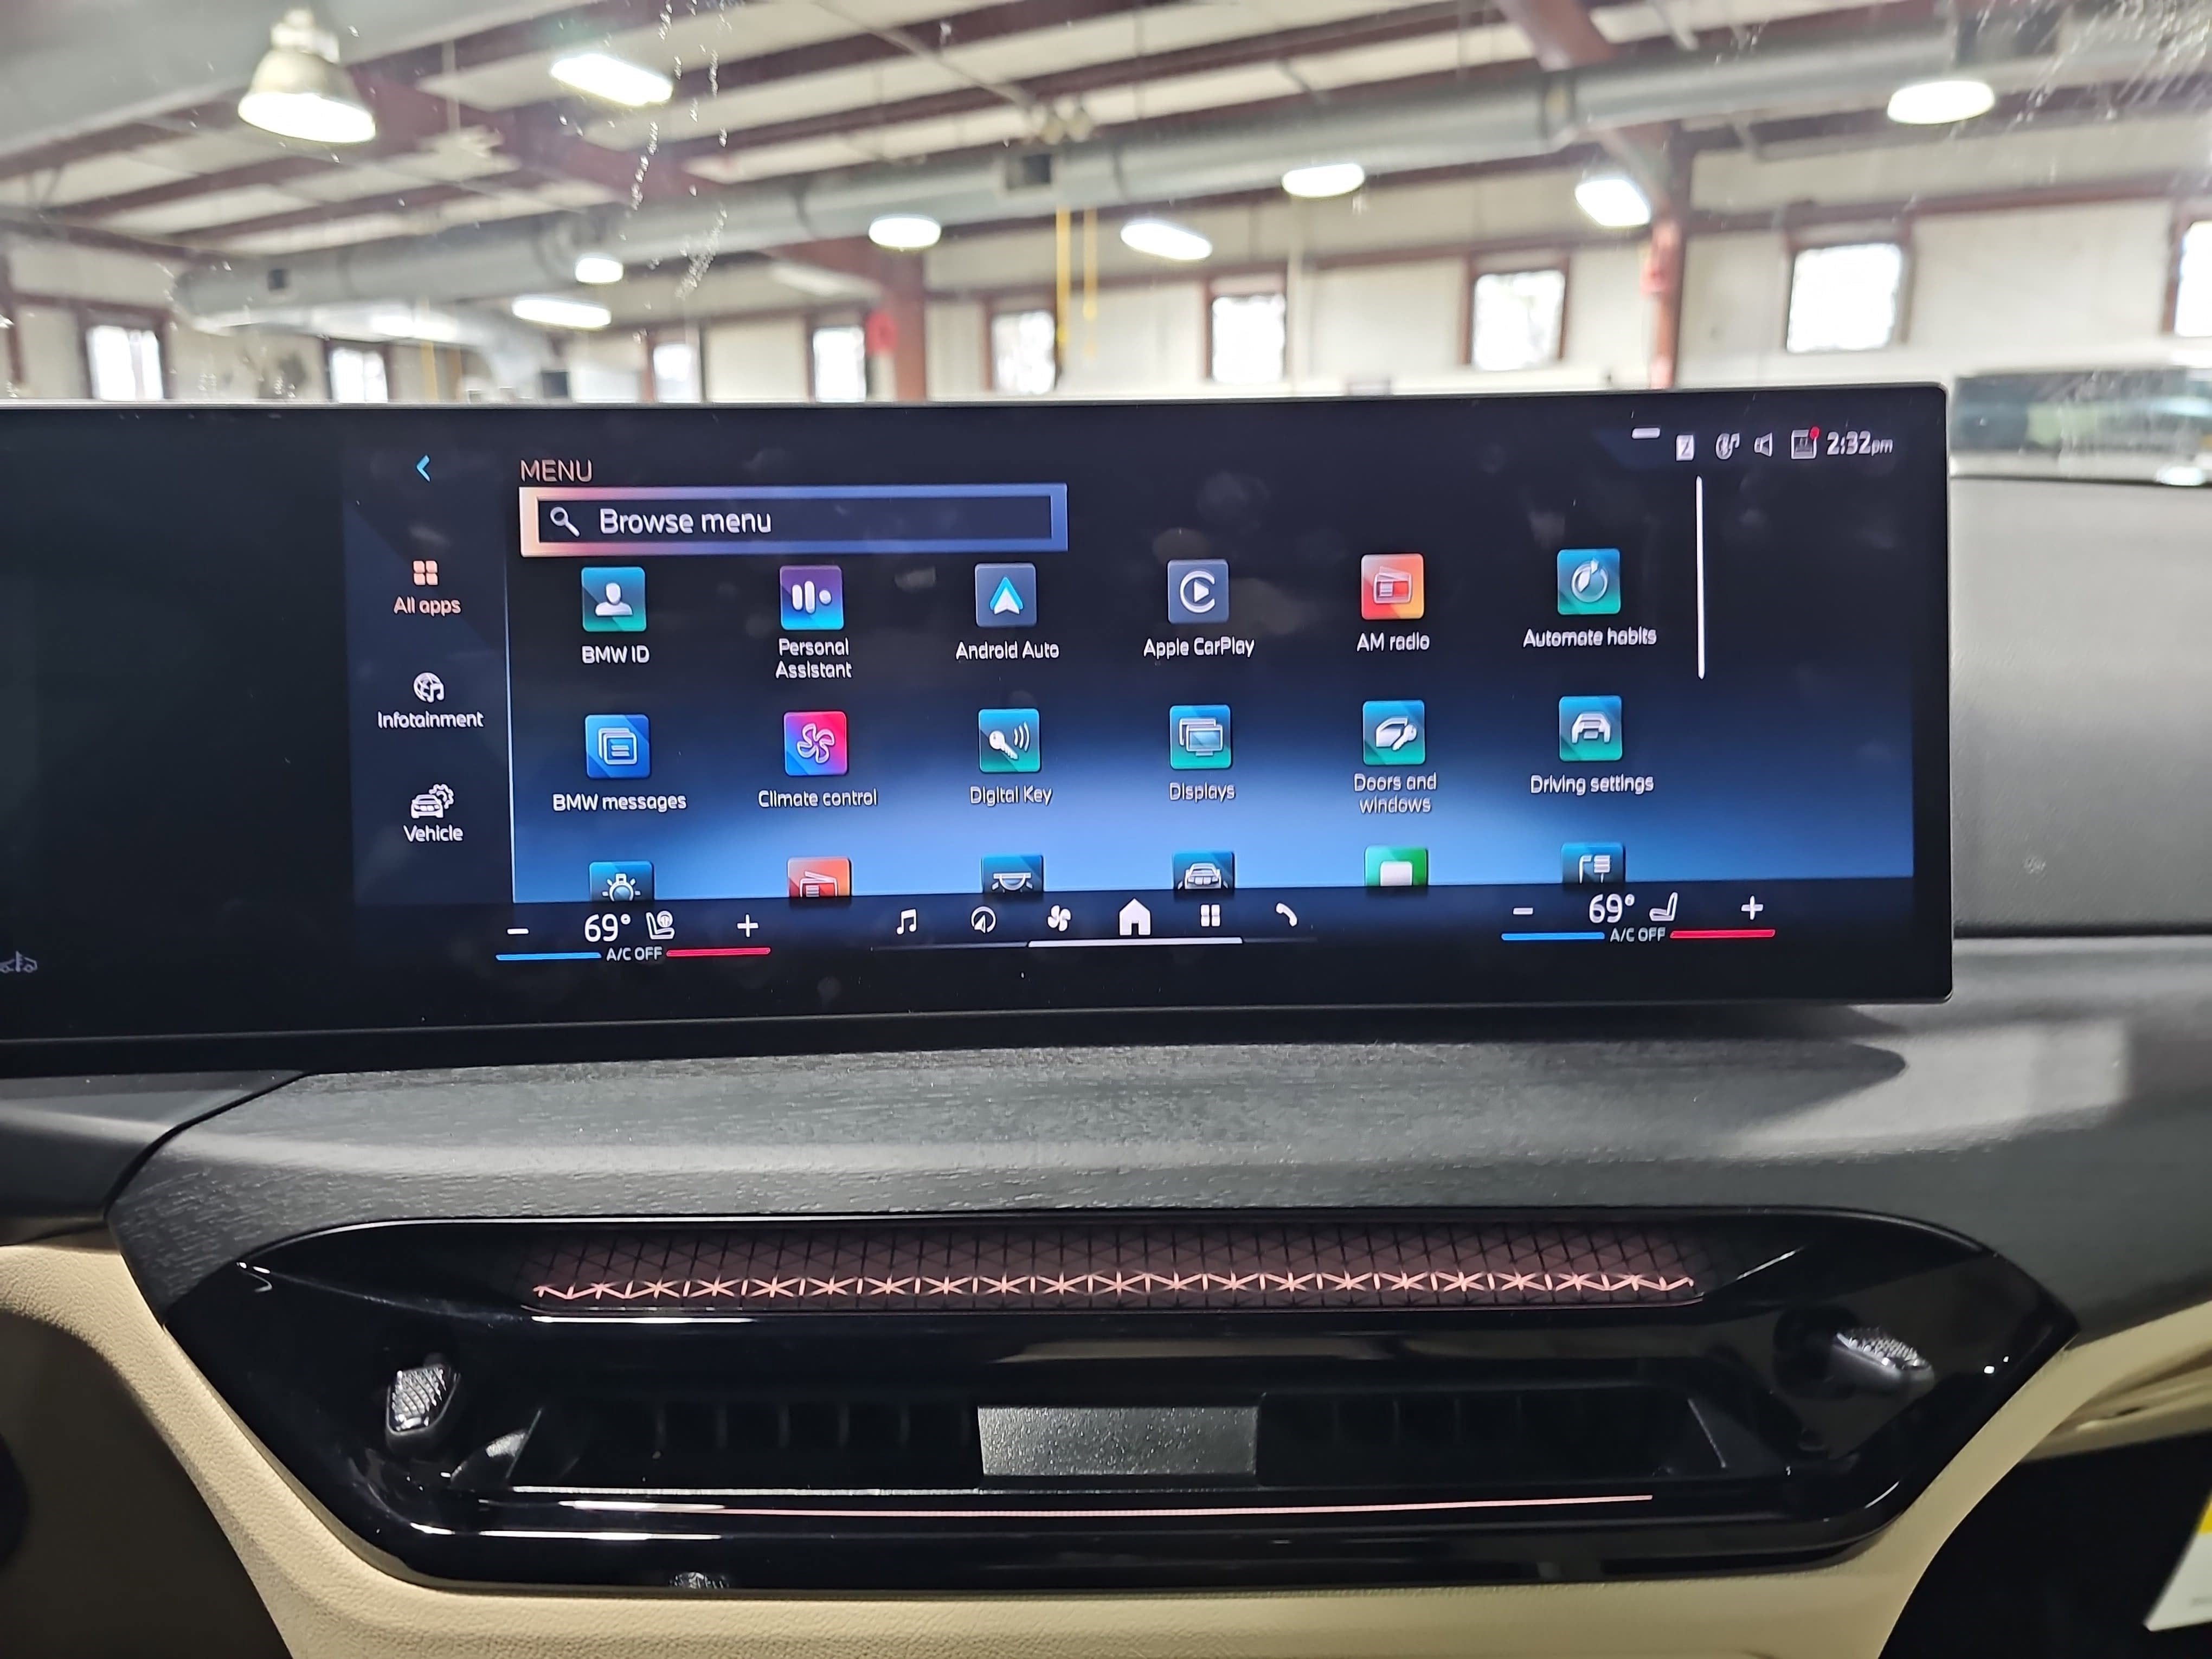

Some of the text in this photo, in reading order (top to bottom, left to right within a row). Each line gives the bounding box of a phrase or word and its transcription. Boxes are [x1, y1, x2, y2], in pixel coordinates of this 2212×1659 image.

[520, 459, 593, 482] MENU
[600, 508, 771, 534] Browse menu
[394, 596, 461, 616] All apps
[1356, 632, 1430, 652] AM radio
[1523, 626, 1657, 647] Automate habits
[582, 645, 650, 664] BMW ID
[779, 638, 849, 656] Personal
[956, 640, 1059, 660] Android Auto
[1143, 635, 1255, 659] Apple CarPlay
[775, 661, 852, 679] Assistant
[378, 711, 484, 729] Infotainment
[1169, 782, 1236, 802] Displays
[1354, 772, 1437, 792] Doors and
[1531, 774, 1654, 796] Driving settings
[552, 793, 687, 813] BMW messages
[758, 788, 877, 808] Climate control
[970, 786, 1052, 806] Digital Key
[1359, 795, 1431, 814] windows
[403, 825, 464, 843] Vehicle
[1609, 927, 1666, 943] A/C OFF
[606, 946, 662, 962] A/C OFF
